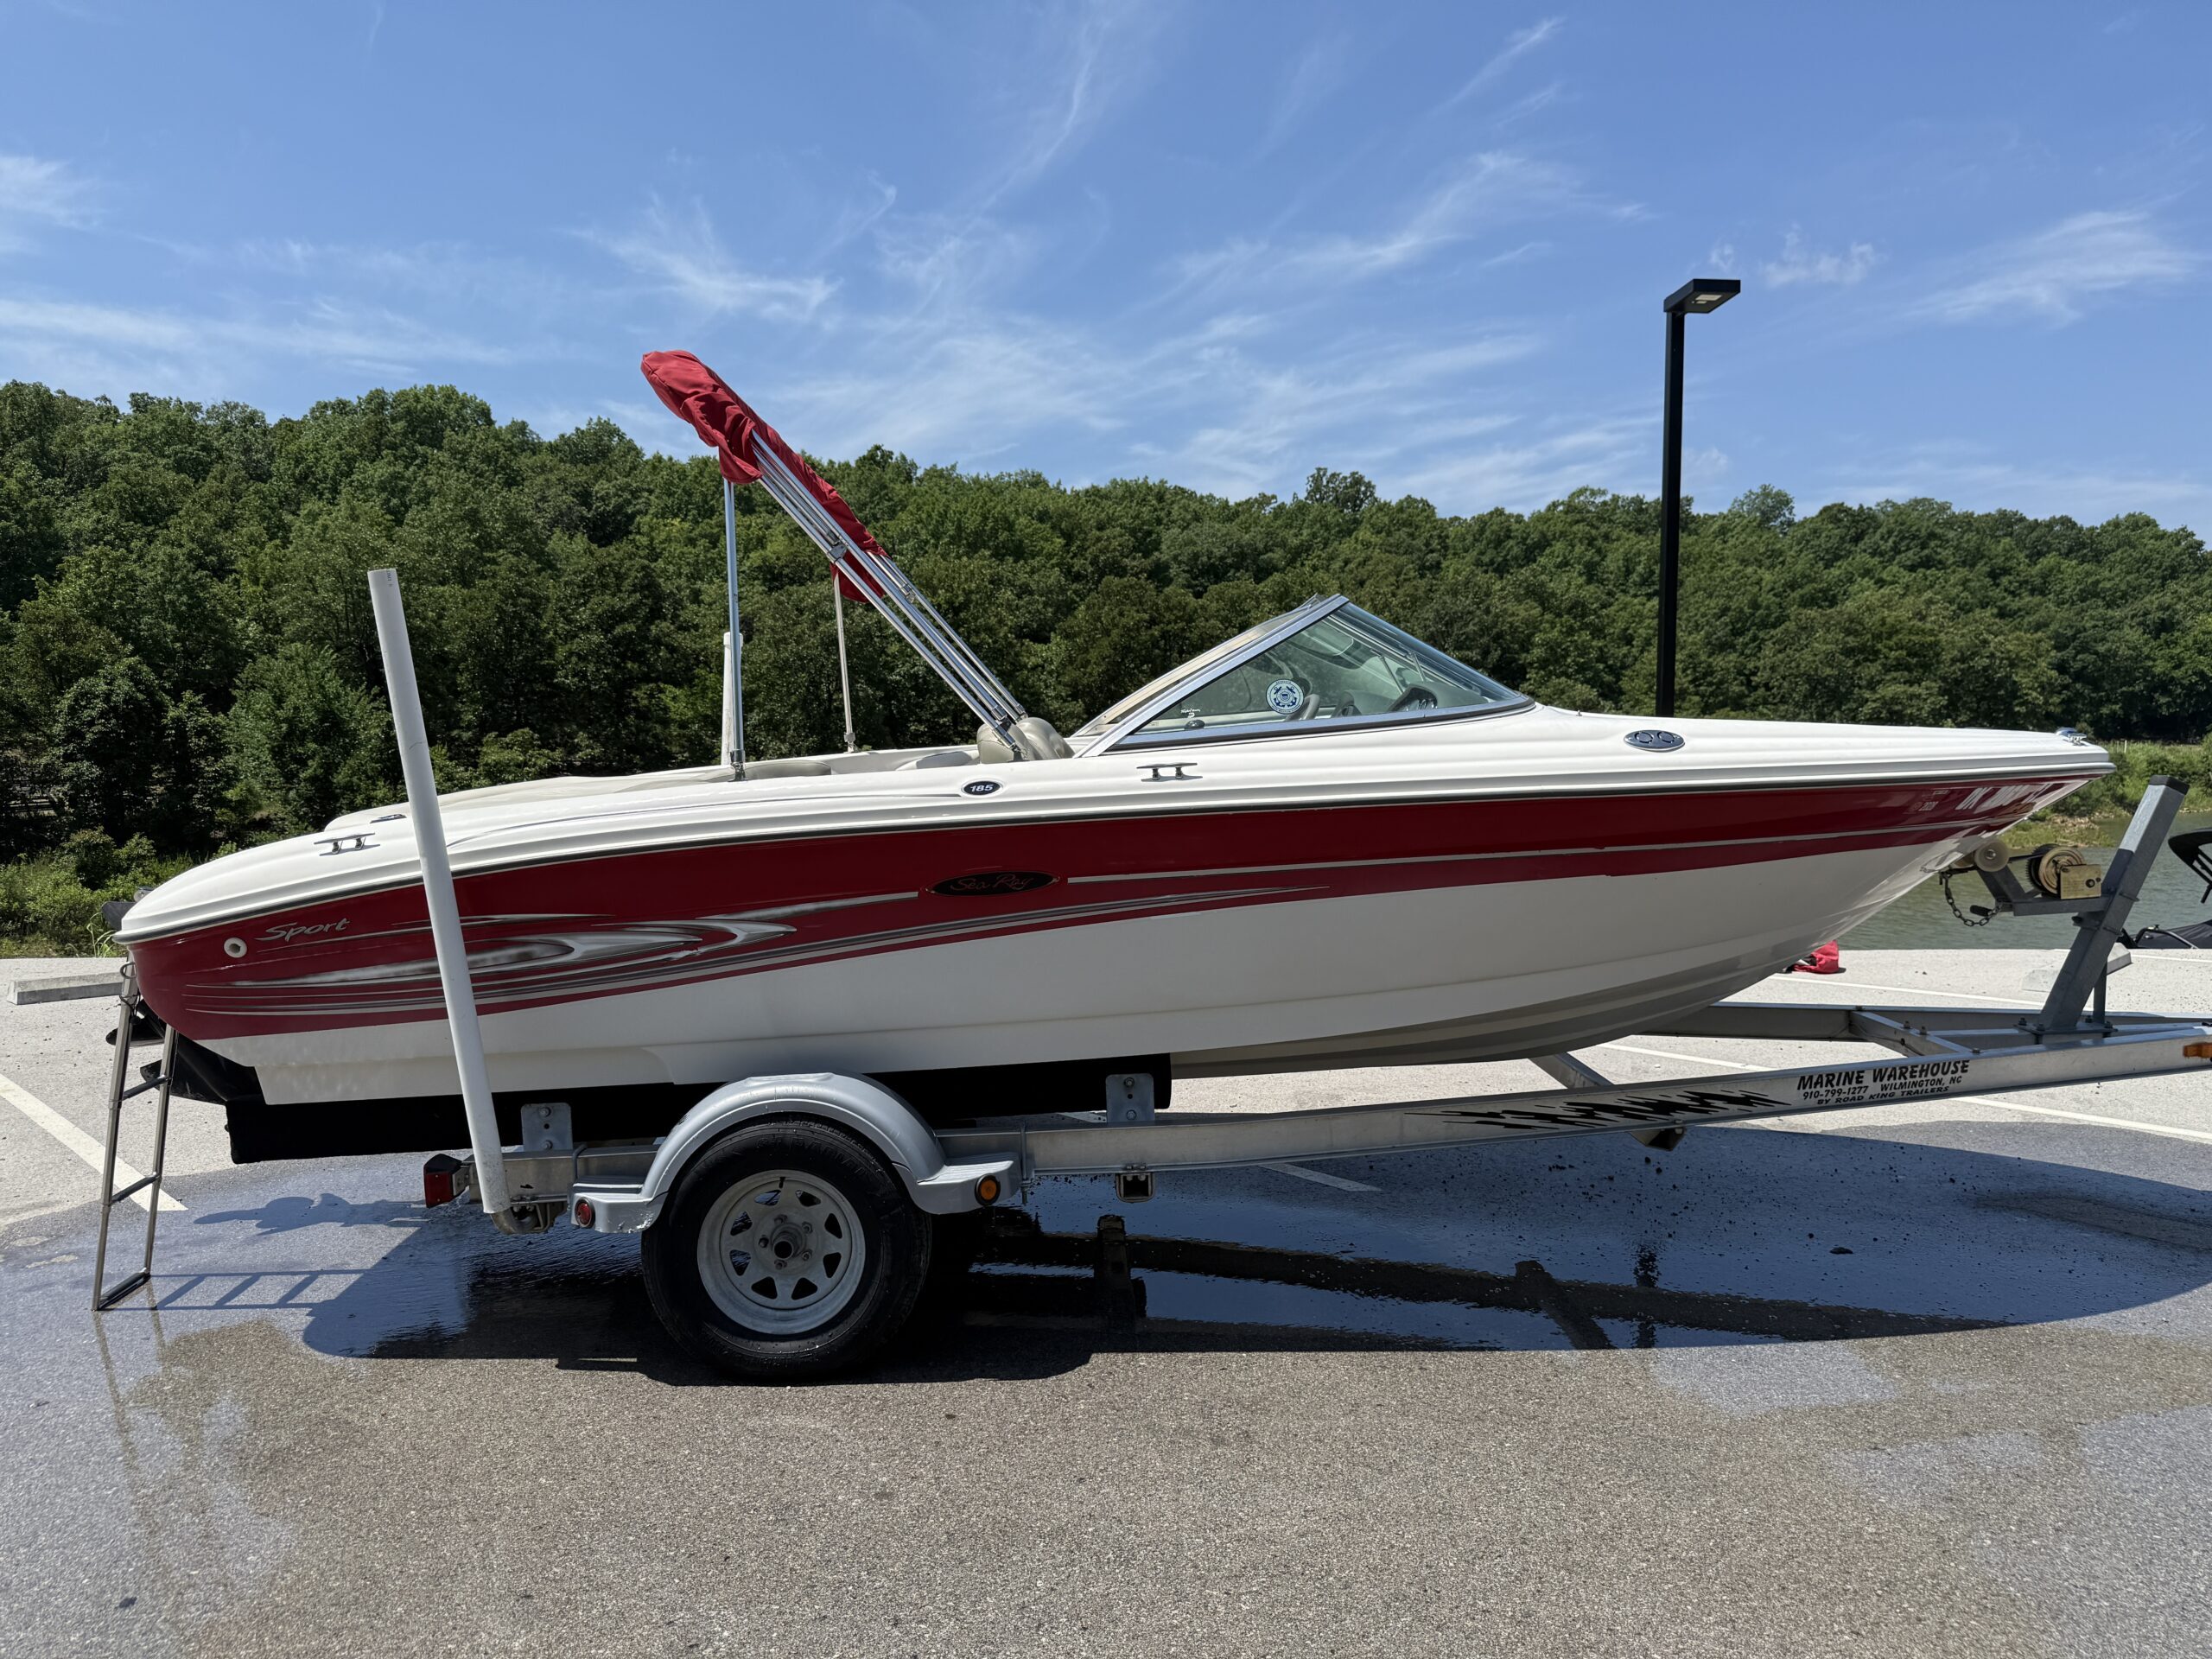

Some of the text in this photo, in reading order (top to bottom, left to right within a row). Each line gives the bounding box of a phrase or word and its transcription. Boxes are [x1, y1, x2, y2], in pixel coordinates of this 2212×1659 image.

[970, 784, 994, 792] 185
[950, 873, 1034, 891] Sea Ray
[254, 918, 351, 943] Sport
[1796, 1059, 1970, 1090] MARINE WAREHOUSE
[1802, 1075, 1962, 1101] 910-799-1277 WILMINGTON, NC
[1834, 1095, 1865, 1103] ROAD
[1868, 1091, 1896, 1100] KING
[1900, 1085, 1950, 1096] TRAILERS
